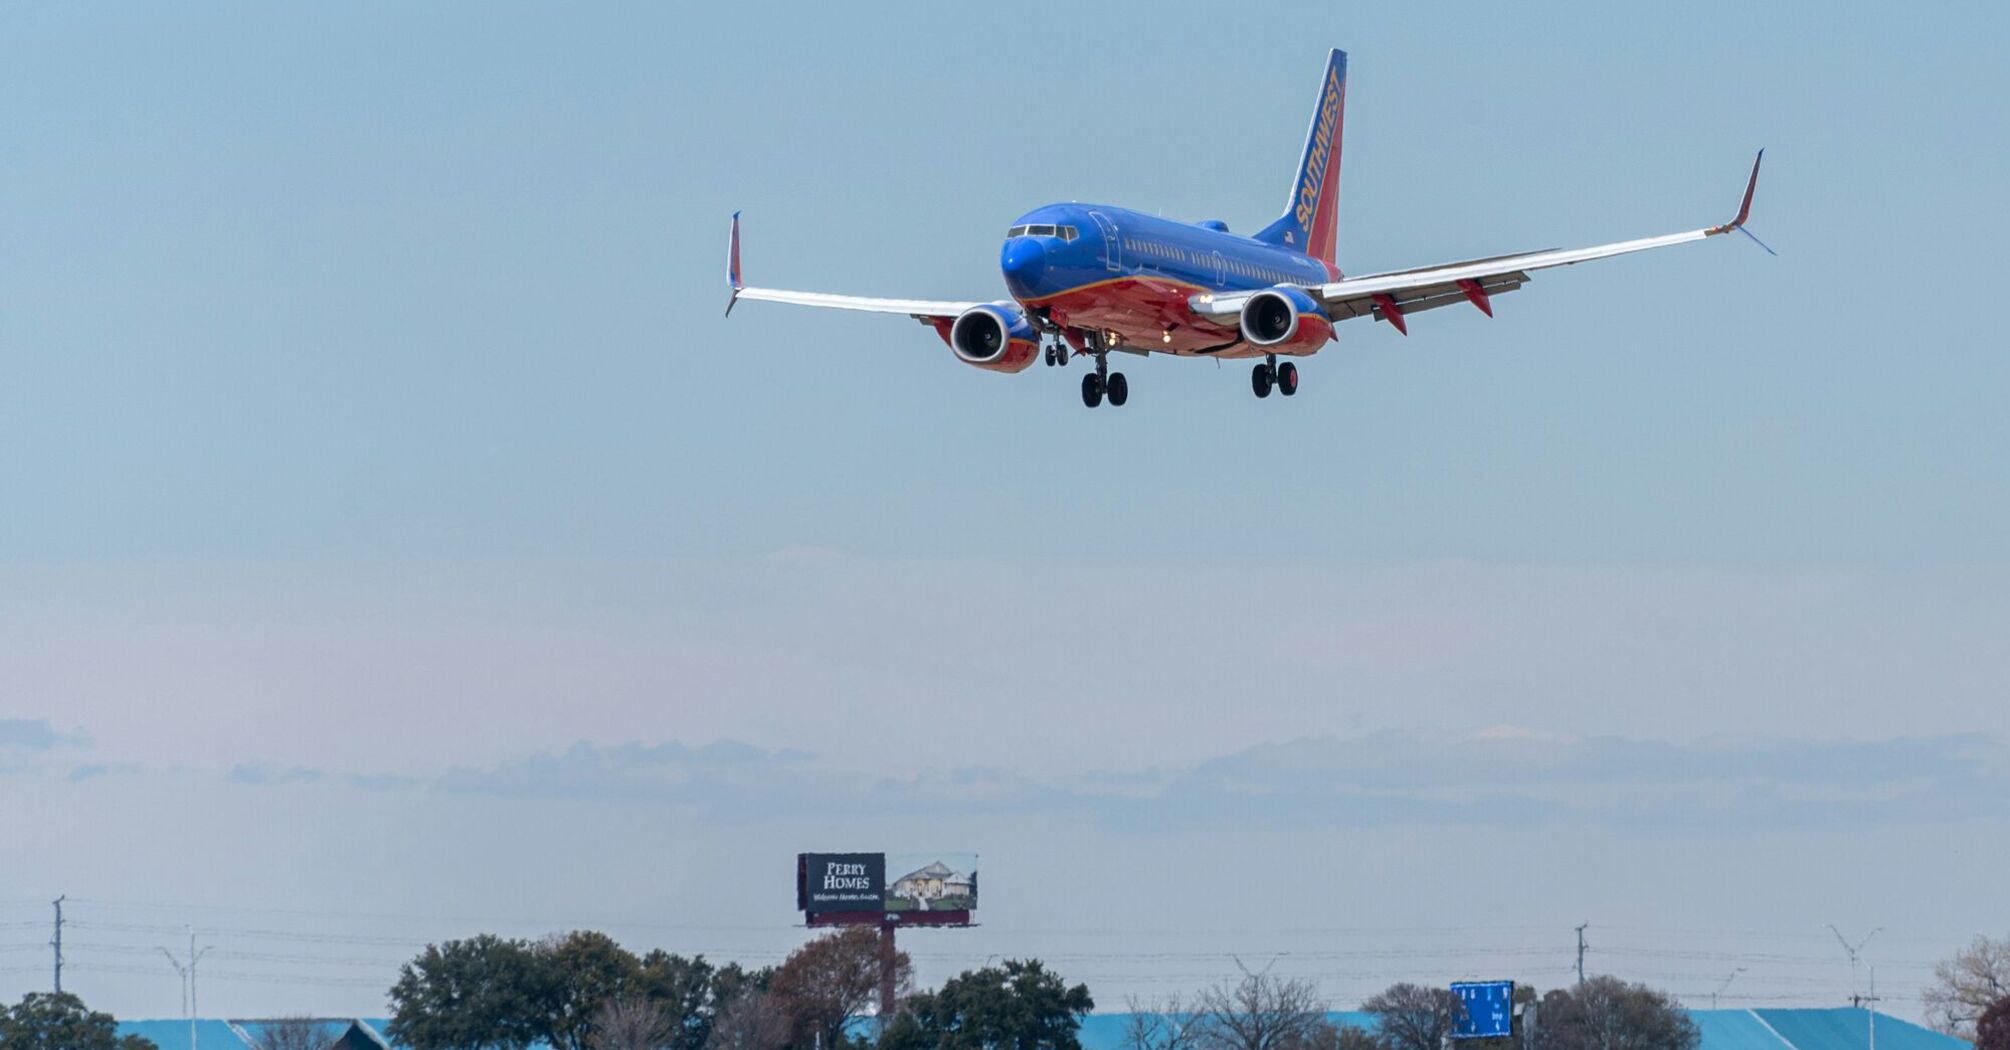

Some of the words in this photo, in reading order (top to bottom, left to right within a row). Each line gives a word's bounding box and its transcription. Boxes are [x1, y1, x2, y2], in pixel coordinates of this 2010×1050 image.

[1296, 66, 1342, 232] SOUTHWEST
[827, 862, 866, 875] PERRY
[824, 875, 870, 889] HOMES
